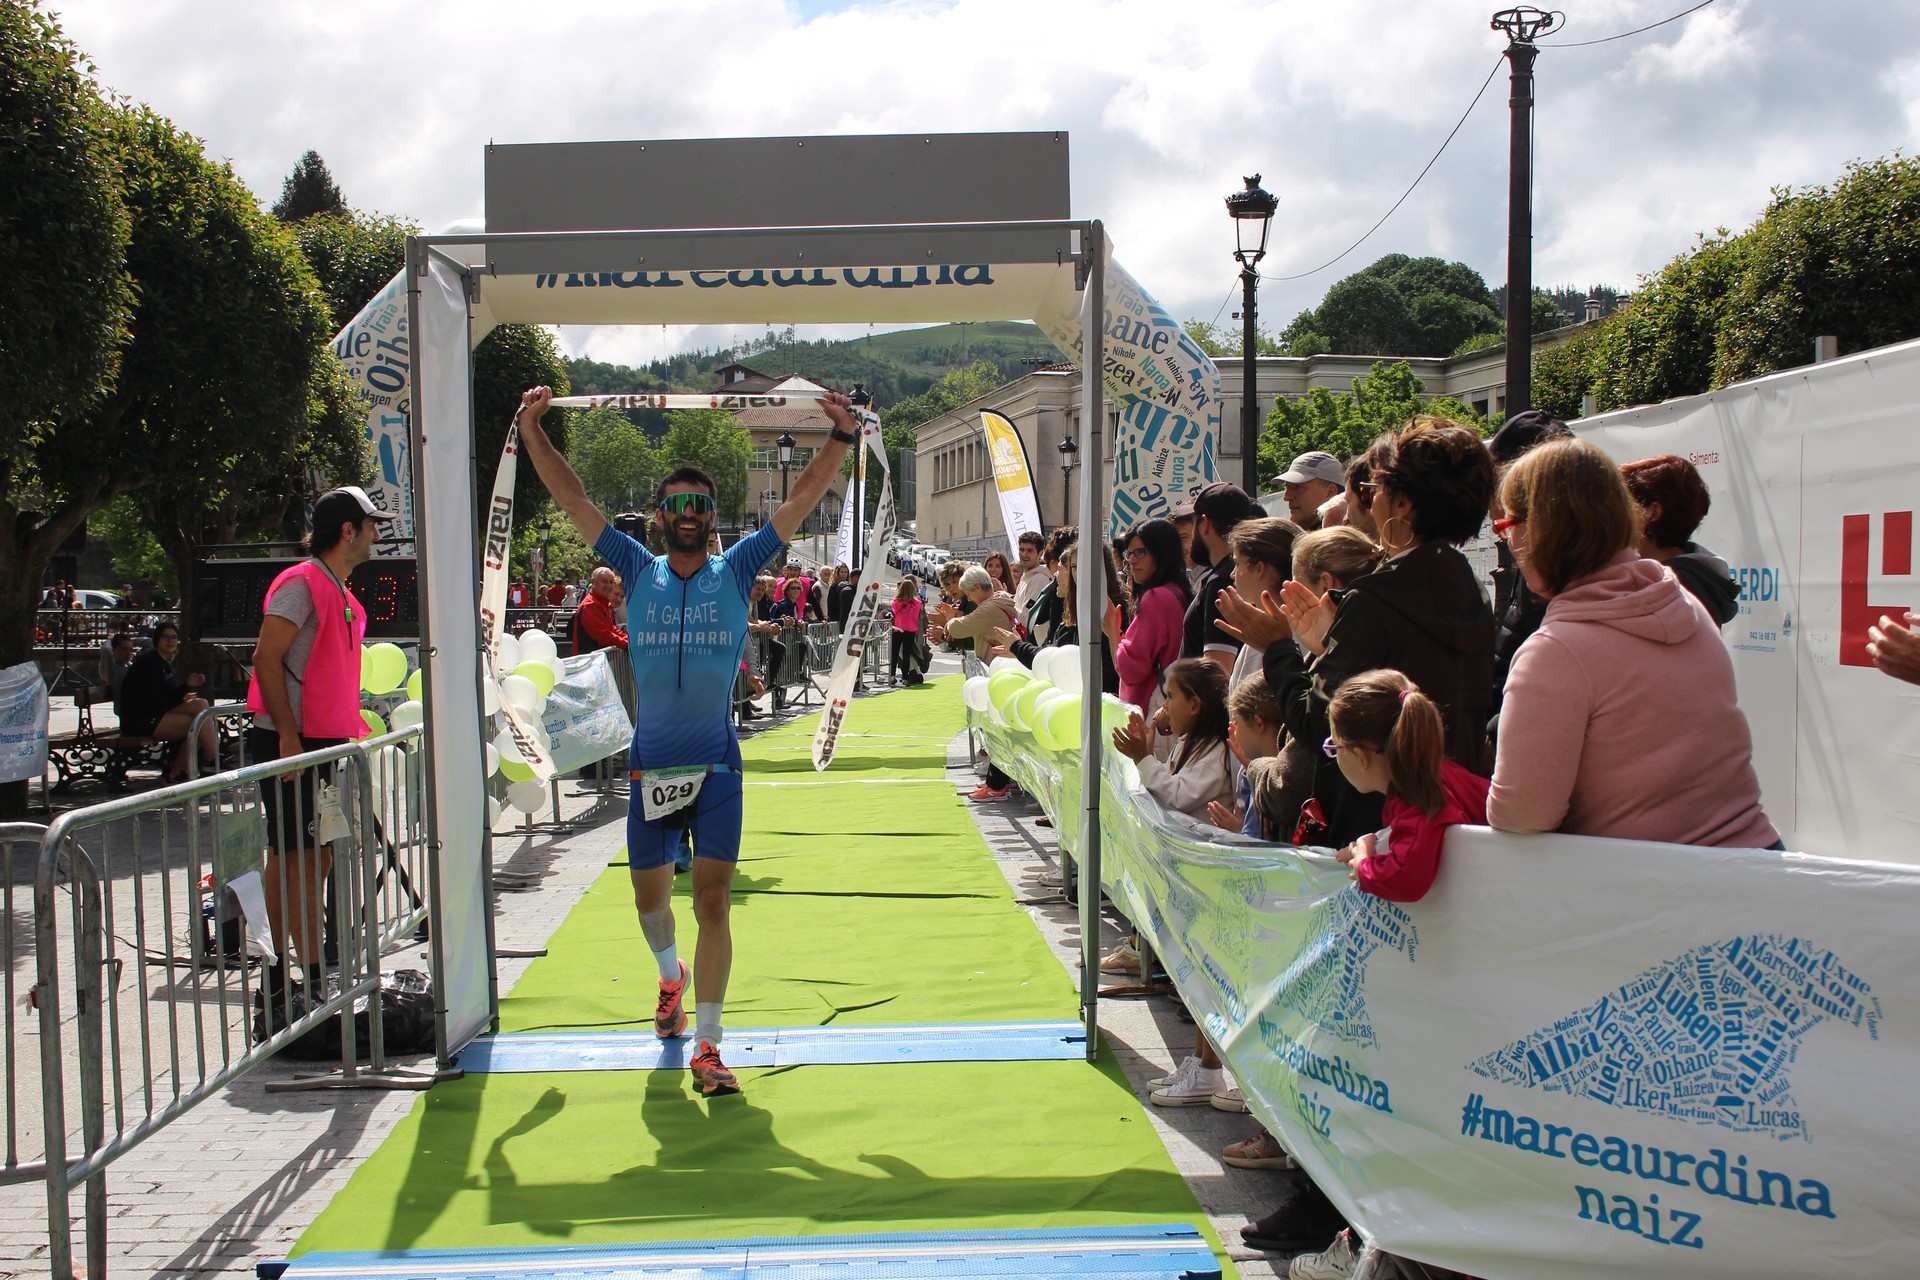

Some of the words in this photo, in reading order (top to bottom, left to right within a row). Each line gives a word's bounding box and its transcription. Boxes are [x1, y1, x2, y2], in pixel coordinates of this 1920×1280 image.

[369, 303, 399, 334] Iraia
[1116, 290, 1143, 316] Iraia
[1112, 346, 1136, 359] Nikole
[1138, 355, 1170, 390] Naroa
[1164, 356, 1184, 385] Ainhize
[1151, 448, 1169, 478] Ainhize
[1167, 456, 1185, 493] Naroa
[646, 602, 657, 624] H.
[637, 631, 732, 646] AMANDARRI
[652, 782, 694, 806] 029
[1362, 914, 1397, 948] June
[1675, 961, 1695, 990] Sara
[1744, 934, 1806, 987] Marcos
[1779, 937, 1855, 1009] Antxon
[1821, 950, 1871, 995] Uxue
[1619, 977, 1658, 1003] Laia
[1695, 955, 1718, 1011] Julene
[1718, 936, 1800, 1025] Amaia
[1719, 969, 1747, 998] Igor
[1655, 972, 1721, 1051] Luken
[1744, 1004, 1765, 1021] Naia
[1797, 982, 1850, 1021] June
[1345, 1017, 1372, 1039] Lucas
[1553, 1015, 1580, 1034] Malen
[1584, 995, 1644, 1077] Nerea
[1635, 997, 1678, 1055] Paule
[1721, 1001, 1751, 1052] Irati
[1865, 1011, 1880, 1041] Udane
[1510, 1039, 1527, 1063] Noa
[1526, 1033, 1603, 1089] Alba
[1653, 1047, 1719, 1085] Oihane
[1587, 1053, 1624, 1105] Lier
[1622, 1077, 1671, 1111] Iker
[1673, 1081, 1716, 1098] Haizea
[1757, 1077, 1791, 1105] Maddi
[1290, 1084, 1331, 1138] naiz
[1667, 1102, 1717, 1121] Martina
[1747, 1101, 1800, 1129] Lucas
[1461, 1093, 1837, 1220] #mareaurdina
[1575, 1183, 1704, 1250] naiz
